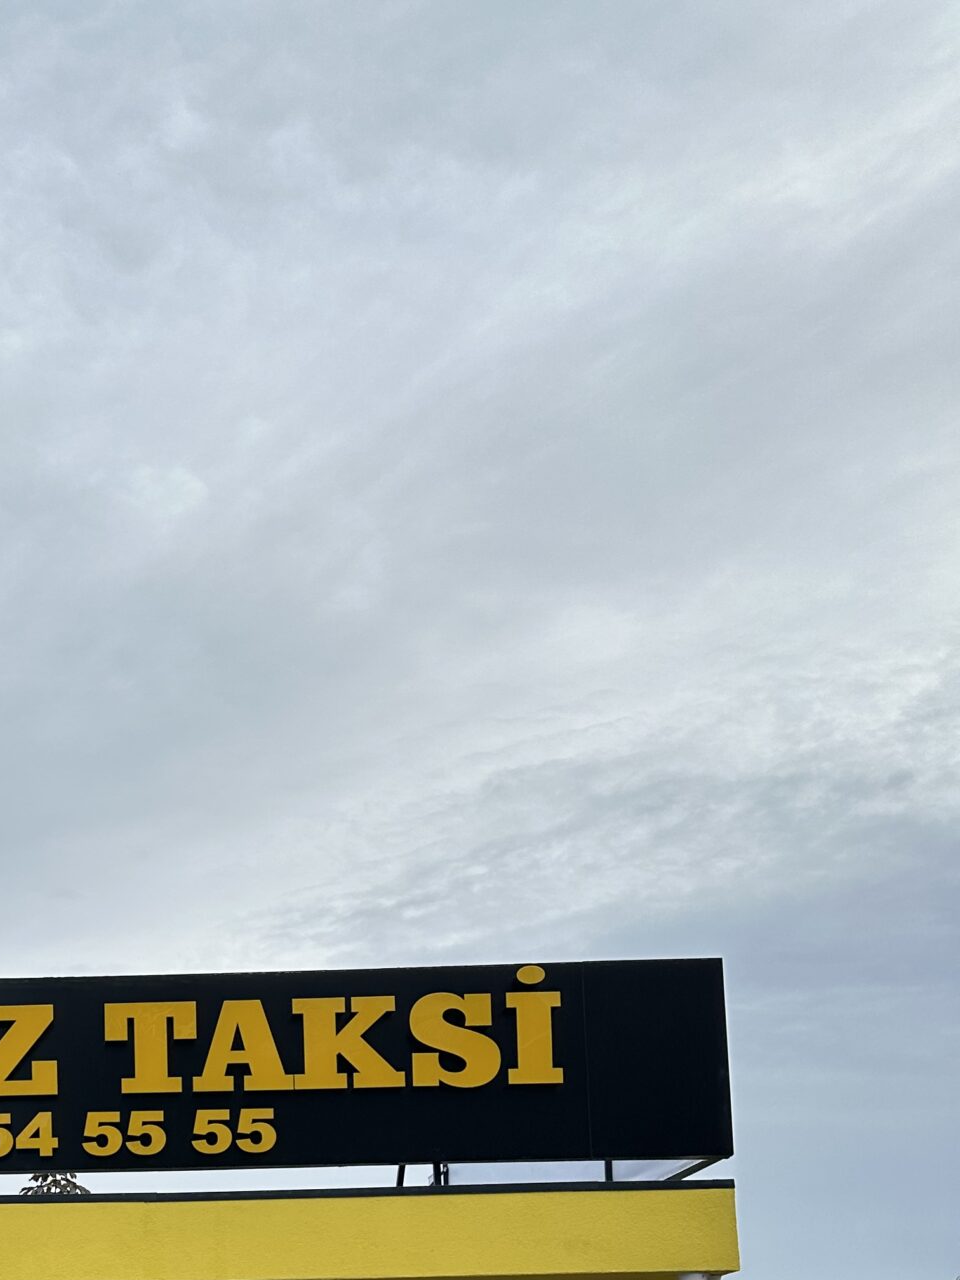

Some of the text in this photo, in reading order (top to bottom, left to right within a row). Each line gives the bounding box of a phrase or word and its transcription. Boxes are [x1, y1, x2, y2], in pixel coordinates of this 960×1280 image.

[104, 965, 565, 1095] TAKSİ
[81, 1110, 168, 1157] 55
[191, 1107, 278, 1155] 55
